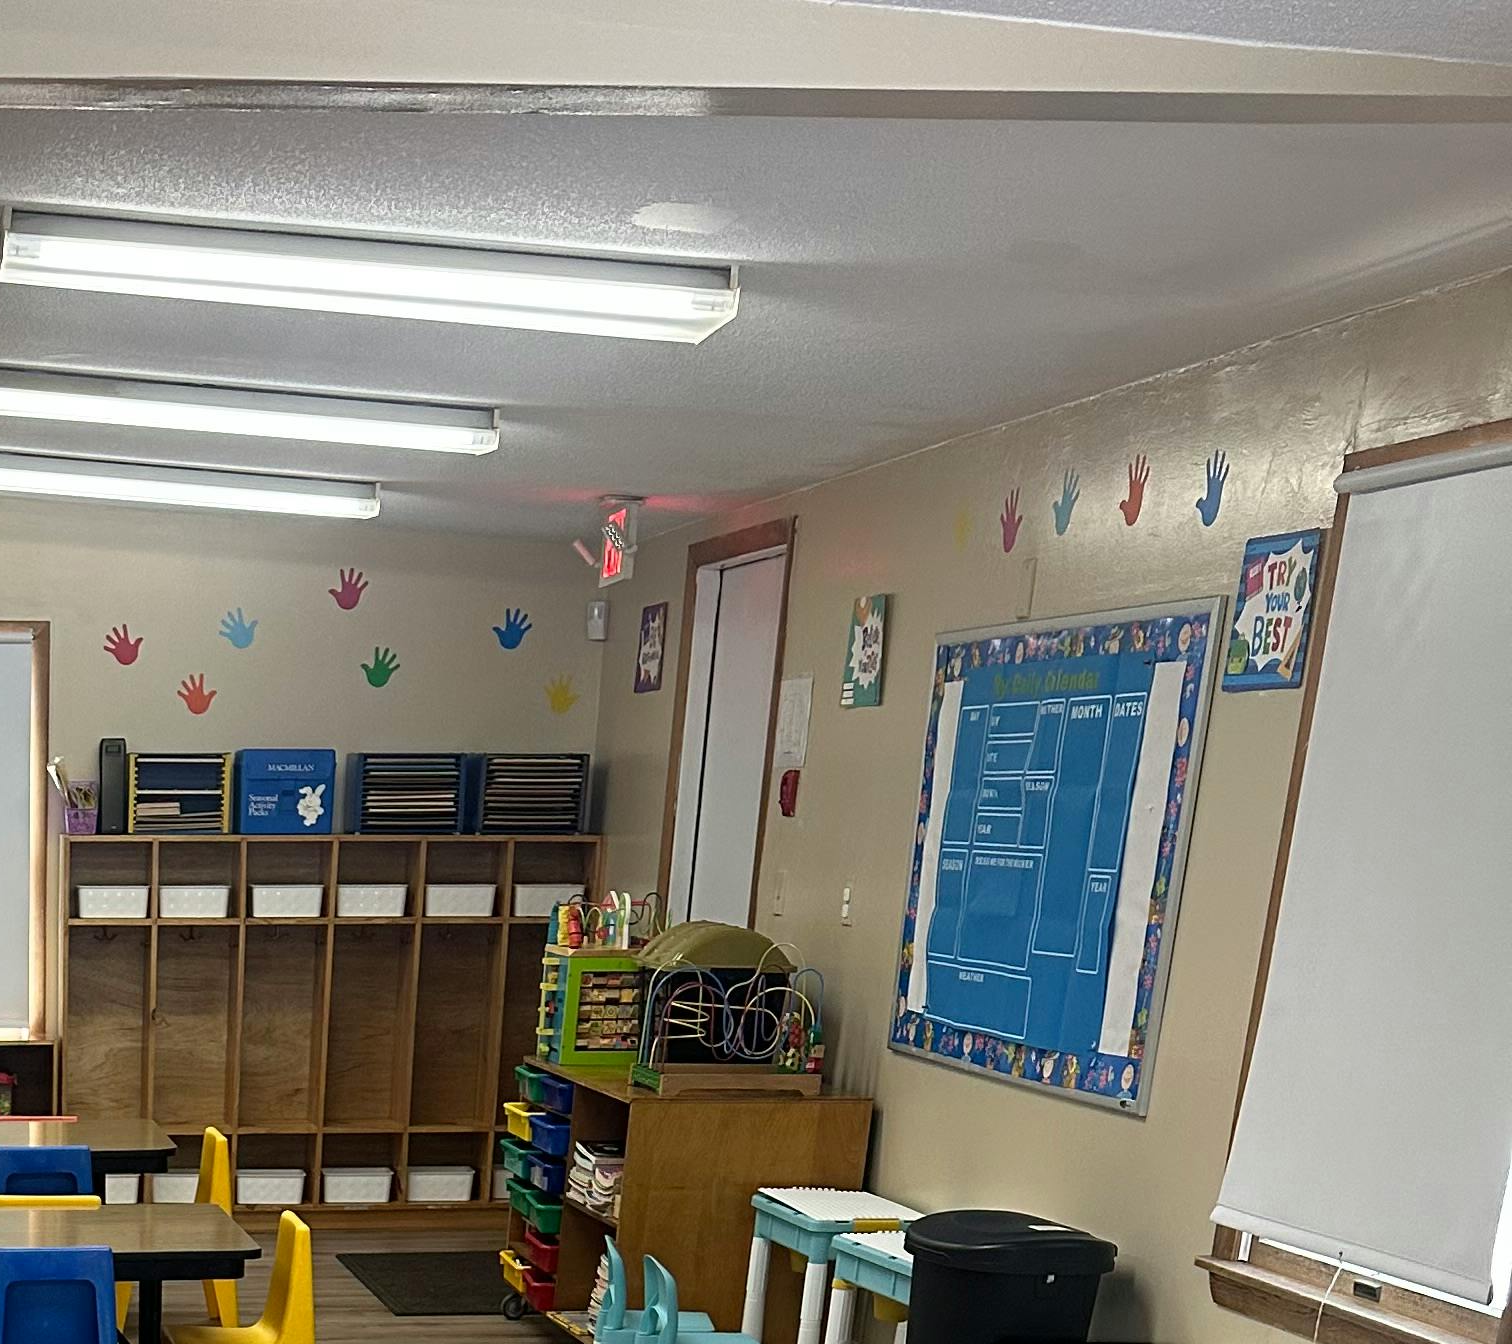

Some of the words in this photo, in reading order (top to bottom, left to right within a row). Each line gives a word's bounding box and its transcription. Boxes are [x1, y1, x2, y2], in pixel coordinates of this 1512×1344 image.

[1268, 556, 1296, 590] TRY
[1266, 592, 1290, 613] YOUR
[1251, 616, 1292, 656] BEST
[1071, 705, 1103, 719] MONTH
[1114, 702, 1143, 718] DATES
[267, 764, 314, 772] MACMILLAN
[248, 793, 278, 802] Seasonal
[1091, 881, 1107, 893] YEAR
